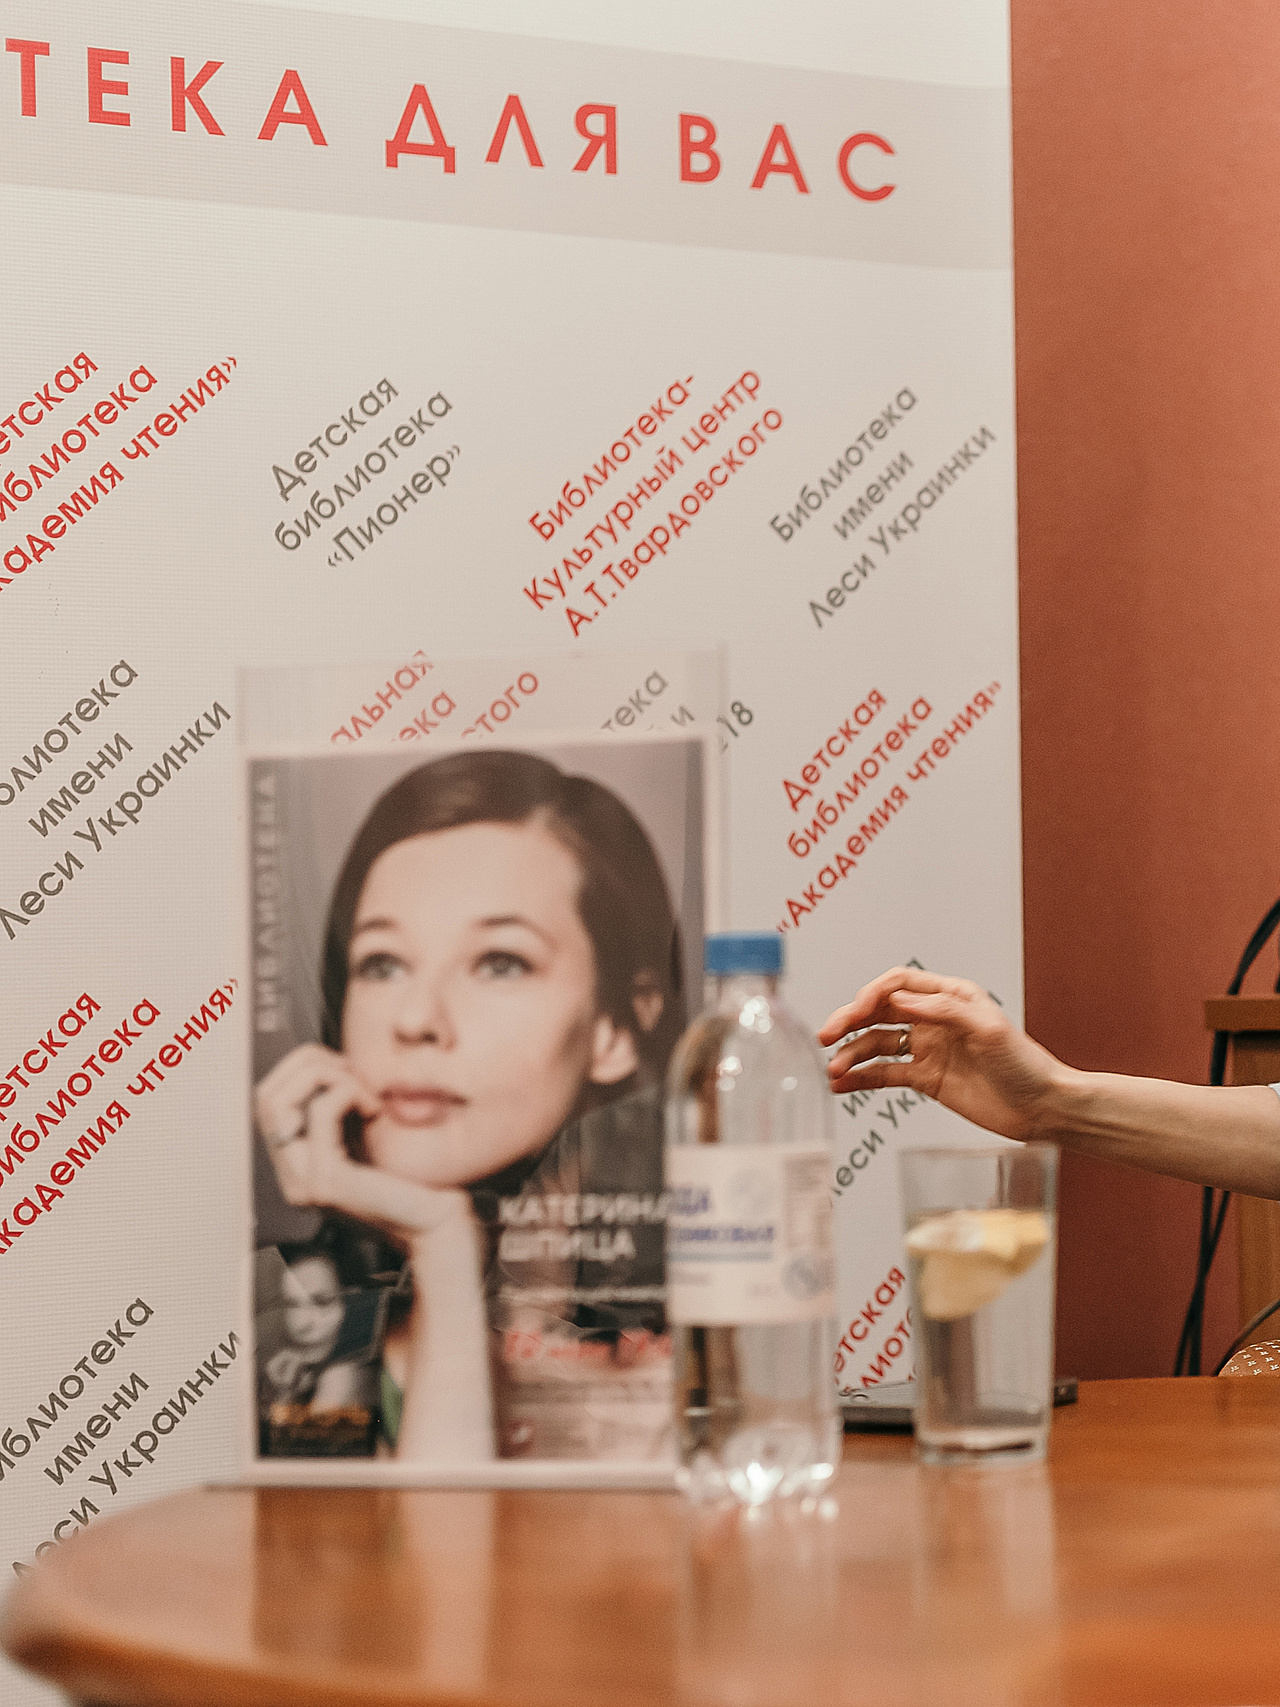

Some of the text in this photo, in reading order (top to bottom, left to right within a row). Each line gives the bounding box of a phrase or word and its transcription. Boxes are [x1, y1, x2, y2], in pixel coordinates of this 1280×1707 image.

[5, 37, 897, 201] ТЕКА ДЛЯ ВАС
[0, 356, 237, 590] адемия чтения»
[271, 378, 399, 502] Детская
[274, 391, 454, 552] библиотека
[327, 444, 462, 568] «Пионер»
[523, 369, 761, 611] Культурный центр
[528, 373, 695, 541] Библиотека-
[769, 386, 918, 543] Библиотека
[832, 451, 914, 541] имени
[564, 407, 783, 637] А.Т.Твардовского
[808, 425, 998, 629] Леси Украинки
[27, 732, 134, 838] имени
[782, 688, 887, 813] Детская
[787, 696, 933, 858] библиотека
[906, 680, 1001, 782] чтения»
[0, 701, 232, 941] Леси Украинки
[0, 992, 102, 1122] етская
[0, 997, 161, 1189] иблиотека
[0, 977, 239, 1255] кадемия чтения»
[832, 1129, 885, 1196] еси
[833, 1266, 906, 1385] етская
[43, 1371, 150, 1486] имени
[87, 1330, 242, 1496] Украинки
